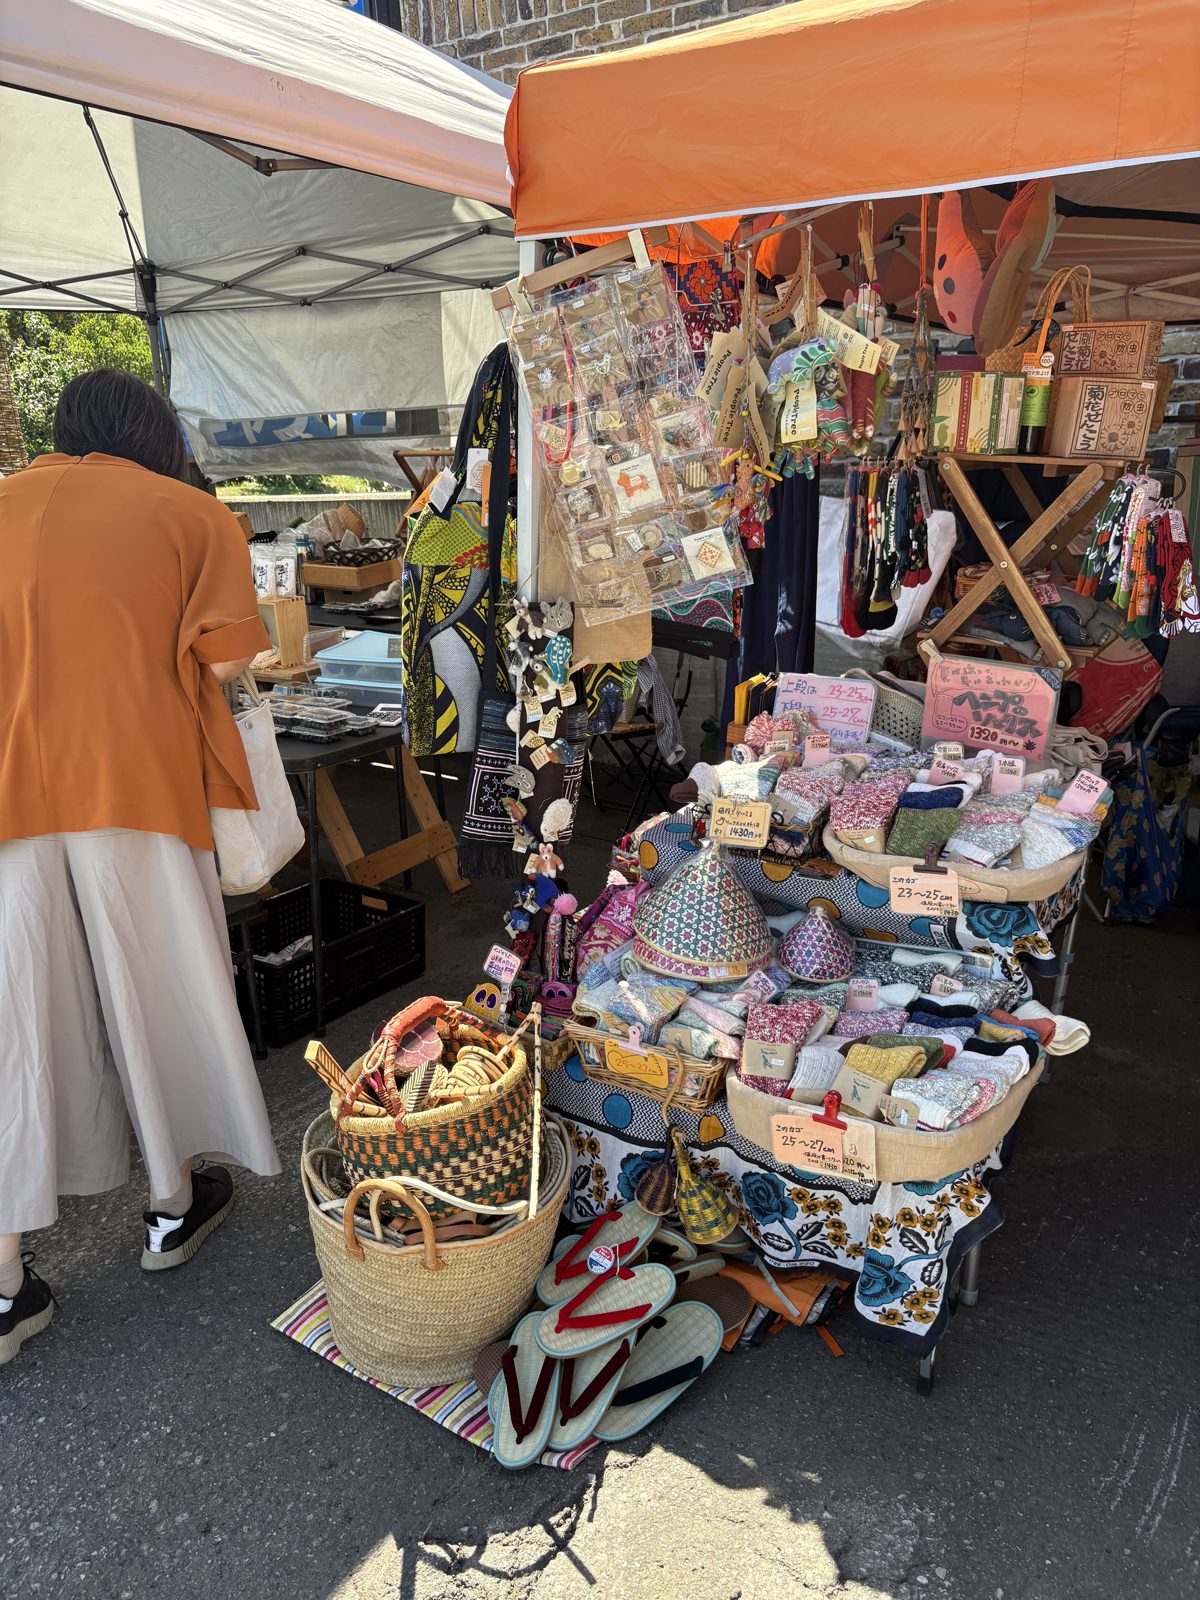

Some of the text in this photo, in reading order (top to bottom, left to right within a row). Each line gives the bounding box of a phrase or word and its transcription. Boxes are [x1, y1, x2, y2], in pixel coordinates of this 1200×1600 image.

[1063, 332, 1080, 370] せんこう
[1114, 341, 1140, 355] 防虫
[705, 350, 732, 396] People Tree
[723, 388, 742, 443] People Tree
[1080, 386, 1105, 450] 菊花せんこう
[1120, 400, 1147, 414] 防虫
[790, 413, 800, 435] Tree
[782, 679, 817, 695] 上段は
[822, 706, 869, 724] 25-27cm
[953, 690, 1028, 716] ヘンプの
[972, 711, 1043, 738] ソックス
[776, 1125, 803, 1133] このカゴ
